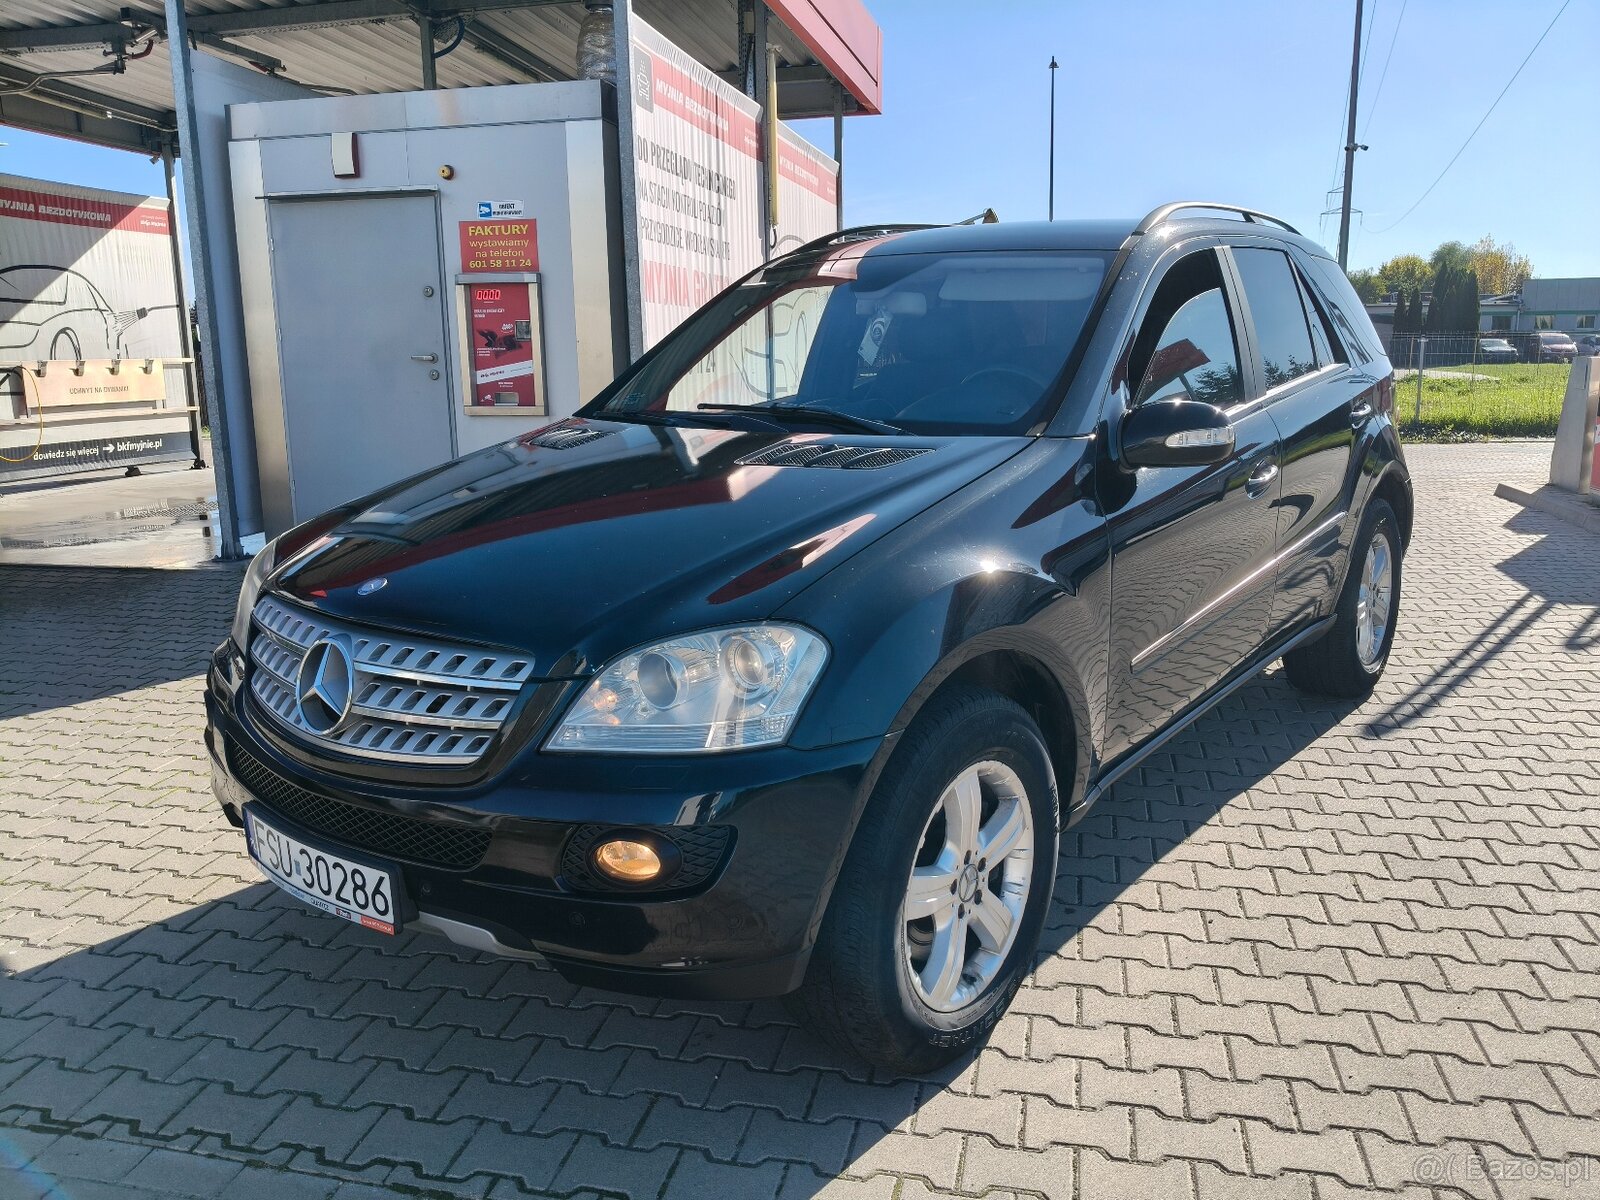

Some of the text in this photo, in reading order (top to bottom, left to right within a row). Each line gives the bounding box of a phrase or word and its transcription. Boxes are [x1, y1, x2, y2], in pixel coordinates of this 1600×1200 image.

[637, 134, 649, 164] DO
[38, 205, 112, 222] BEZDOTYKOWA
[468, 224, 529, 236] FAKTURY
[469, 239, 529, 249] wystawiamy
[475, 249, 524, 258] na telefon
[469, 259, 532, 268] 601 58 11 24
[94, 386, 103, 394] NA
[33, 439, 163, 461] dowiedz się więcej bkfmyjnie.pl
[253, 818, 390, 917] FSU 30286
